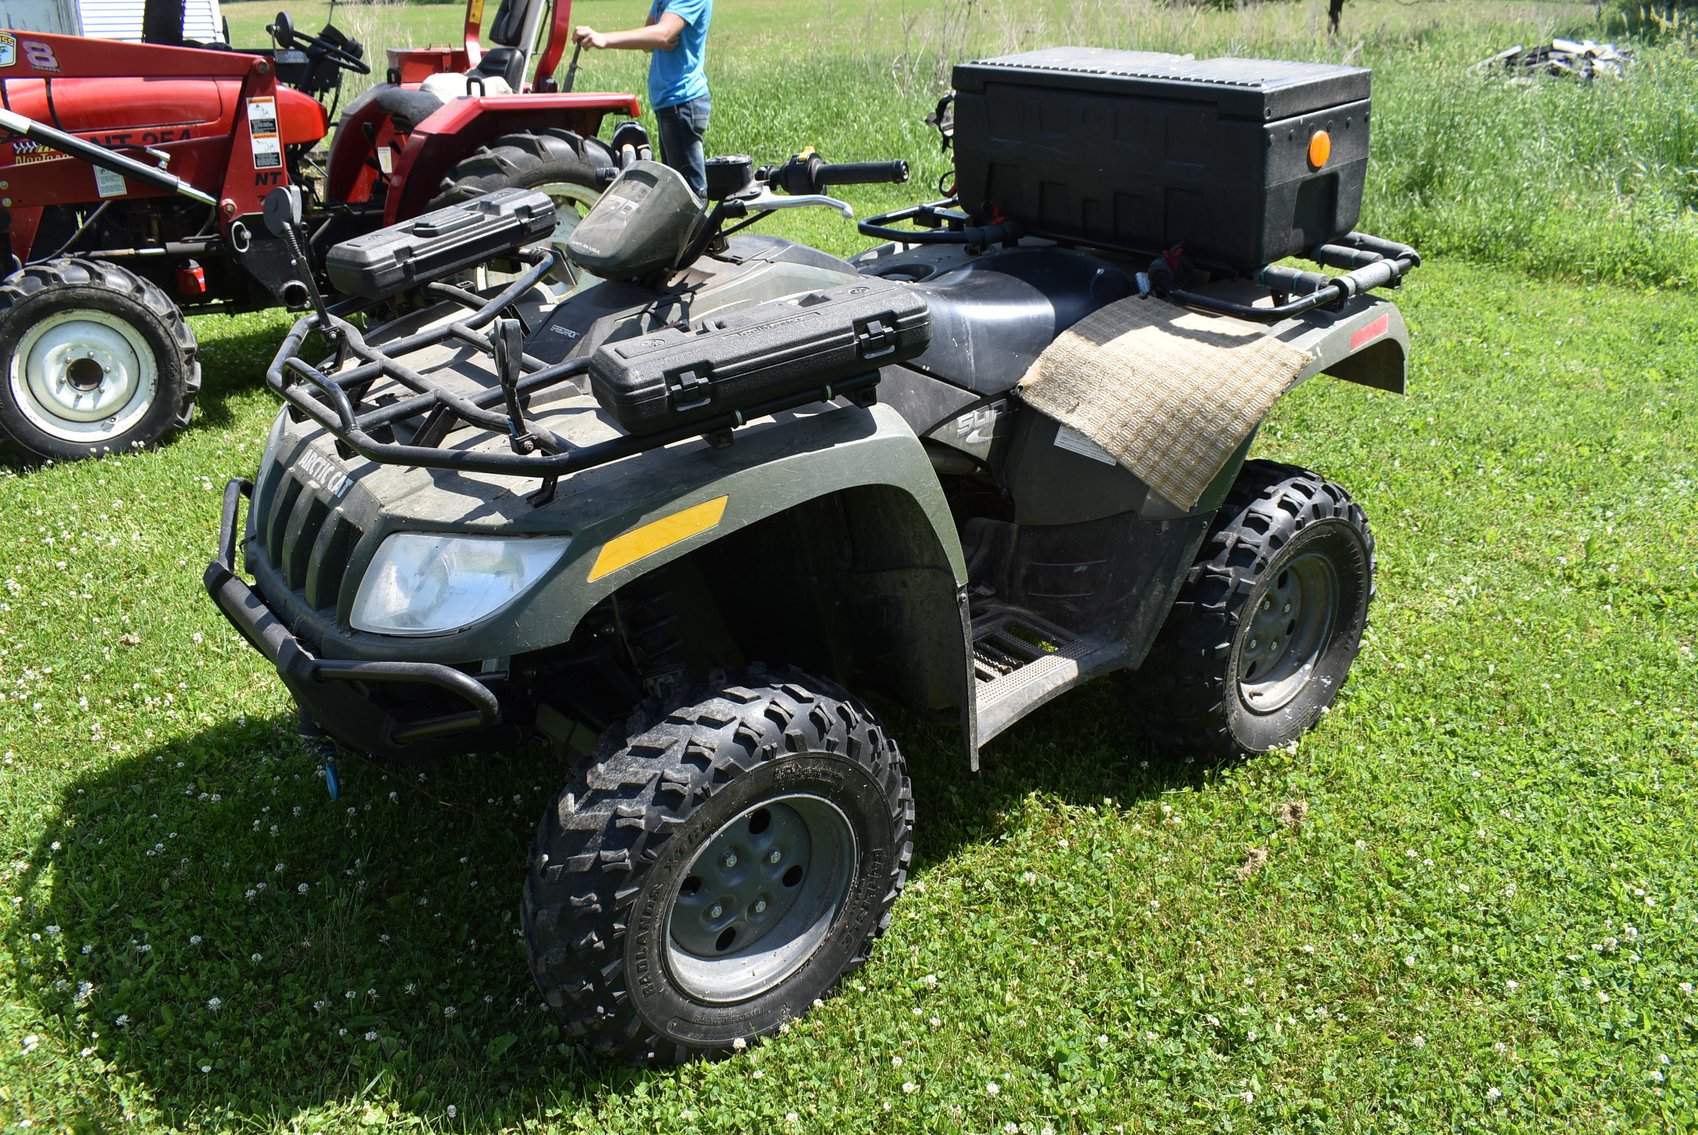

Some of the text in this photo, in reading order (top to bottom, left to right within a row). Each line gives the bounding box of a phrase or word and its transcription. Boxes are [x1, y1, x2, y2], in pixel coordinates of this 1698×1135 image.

[22, 40, 59, 68] 8
[255, 172, 283, 186] NT
[298, 449, 354, 498] ARCTIC CAT
[635, 882, 664, 998] BADLANDS
